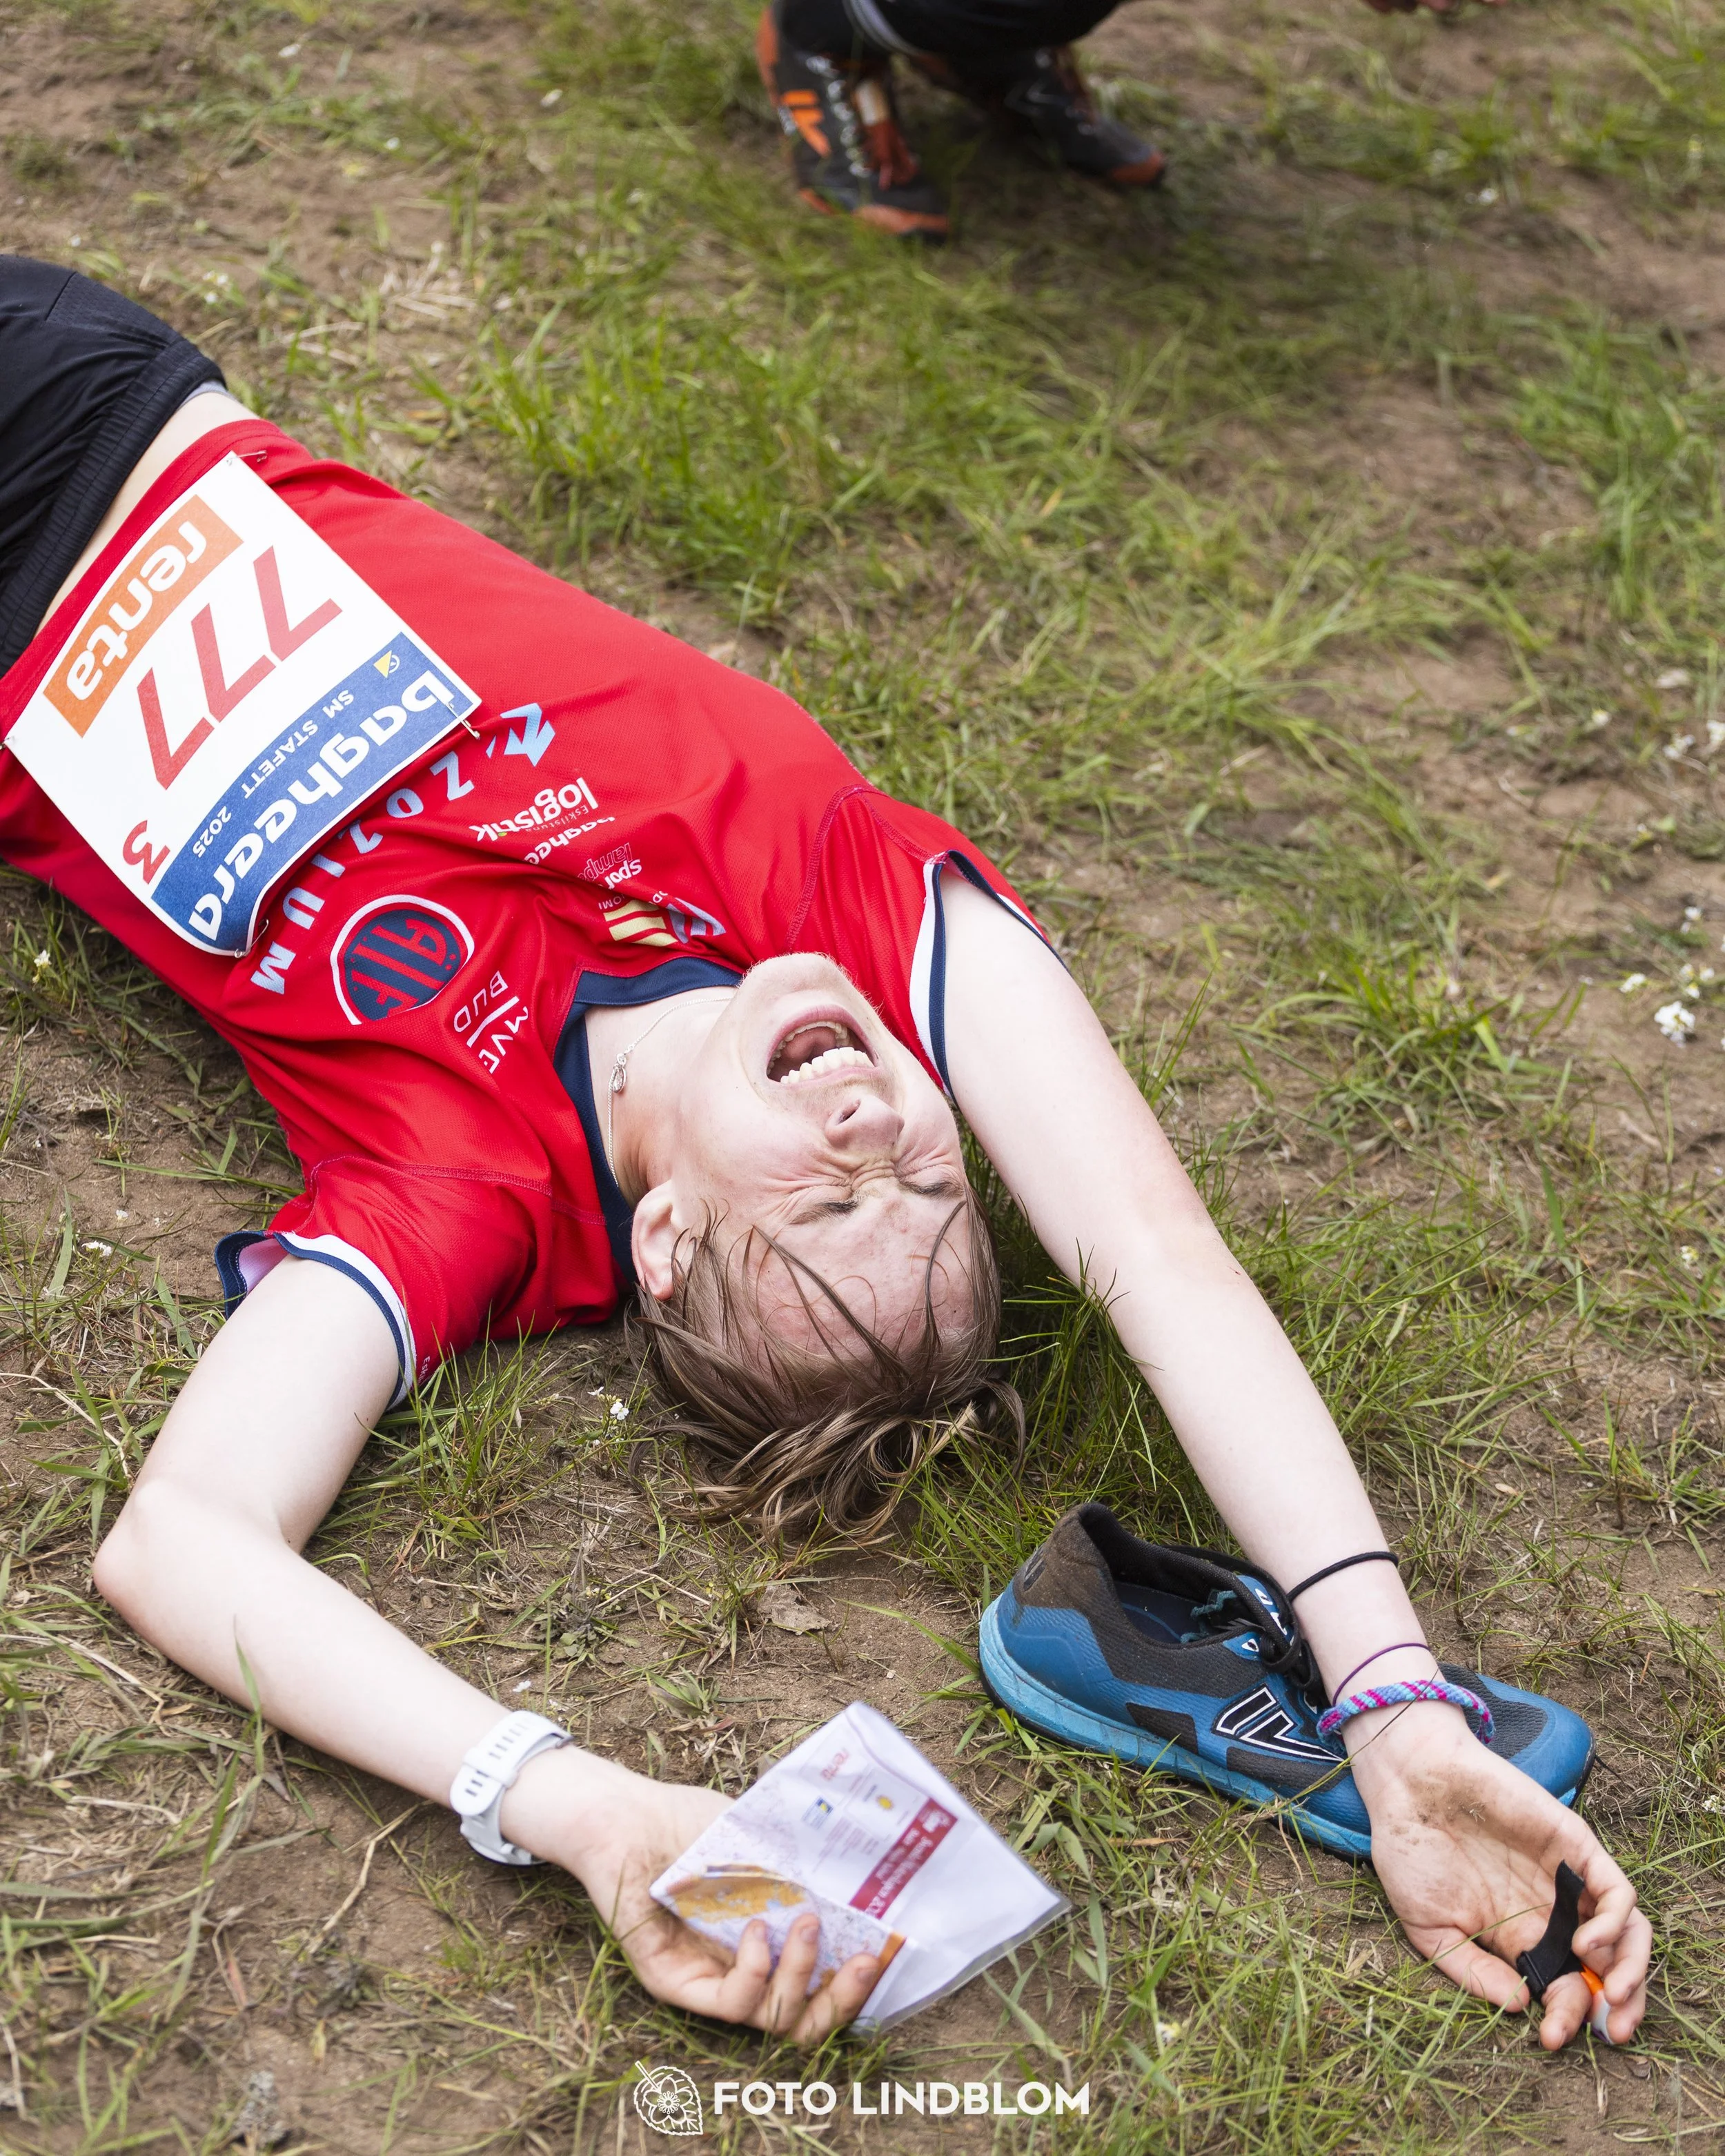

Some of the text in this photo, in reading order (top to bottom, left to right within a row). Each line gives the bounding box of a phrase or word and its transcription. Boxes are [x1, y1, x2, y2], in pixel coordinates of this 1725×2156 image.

[66, 520, 208, 702] renta
[137, 546, 343, 791] 777
[188, 671, 454, 941] bagheera
[193, 689, 354, 860] SM STAFETT 2025
[469, 778, 599, 841] logistik
[122, 820, 170, 885] 3
[599, 859, 642, 890] spor
[453, 971, 509, 1032] BUD
